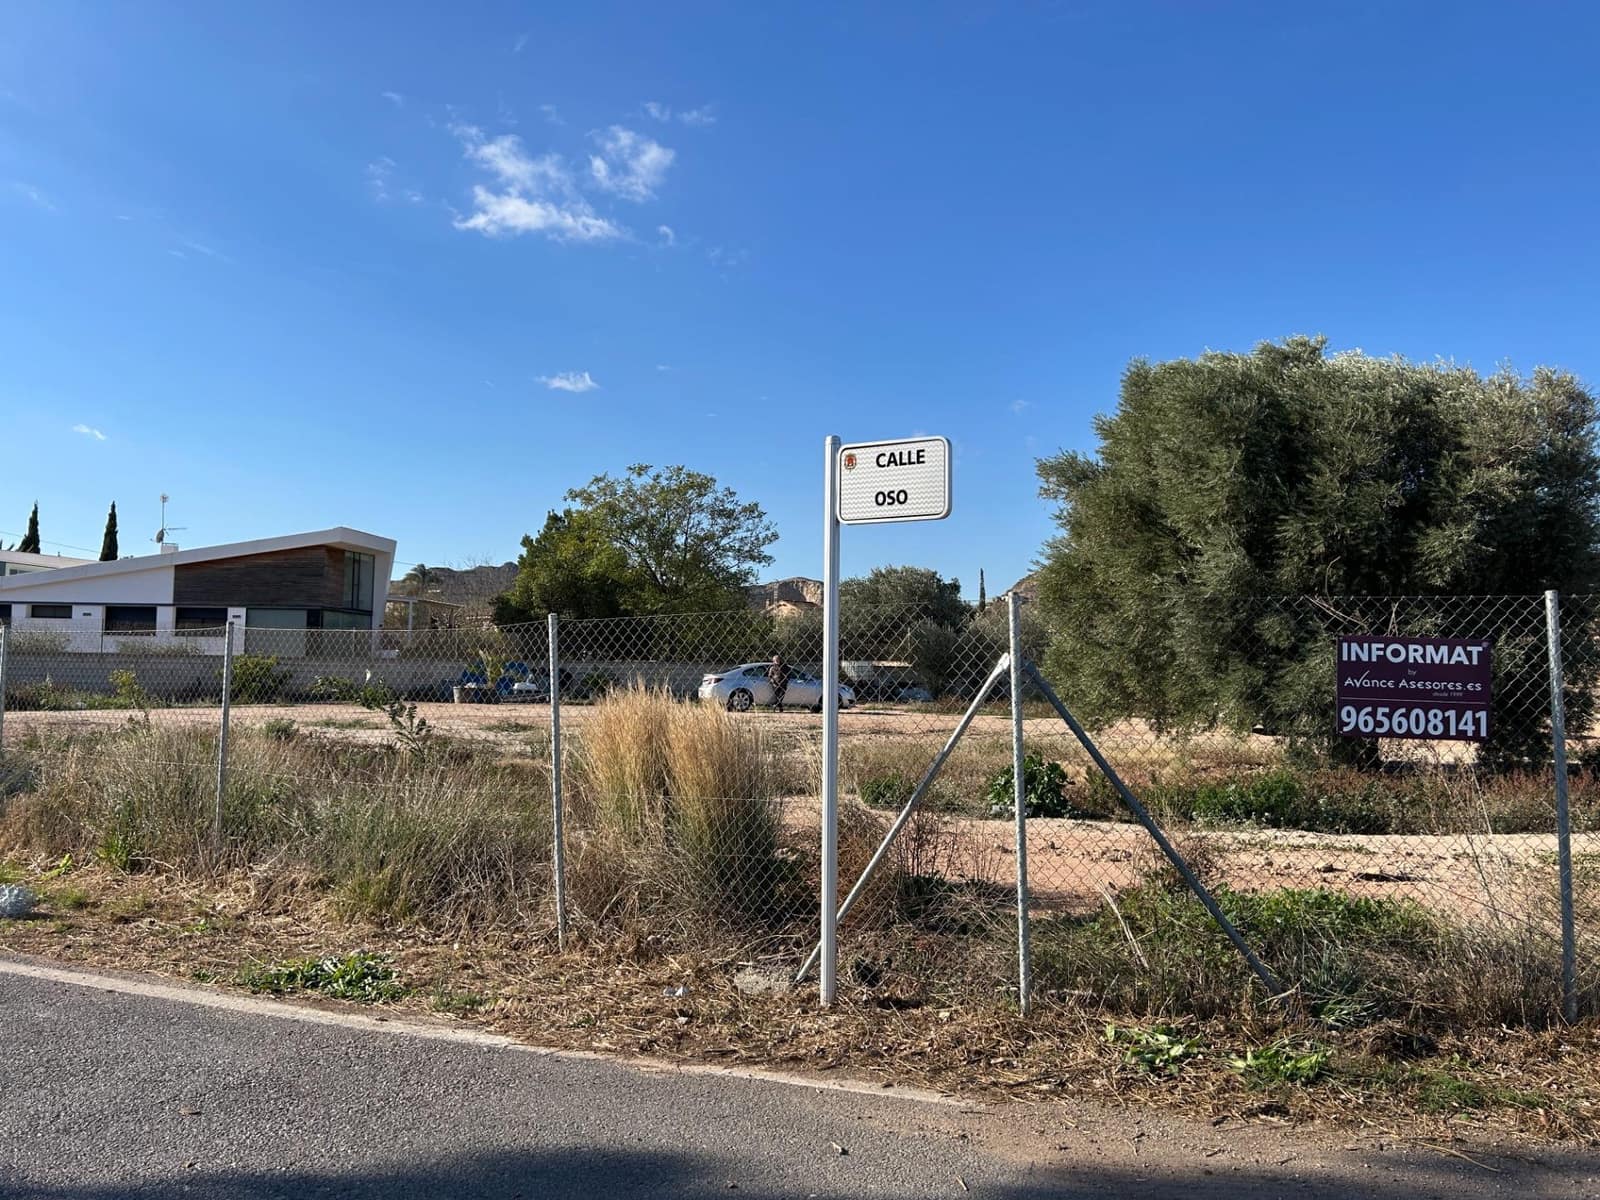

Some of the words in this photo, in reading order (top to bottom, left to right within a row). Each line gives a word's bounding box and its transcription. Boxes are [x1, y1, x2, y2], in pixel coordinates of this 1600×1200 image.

[875, 449, 926, 468] CALLE
[874, 489, 909, 506] OSO
[1341, 642, 1484, 666] INFORMAT
[1343, 670, 1395, 689] Avance
[1398, 679, 1483, 692] Asesores.es
[1340, 705, 1488, 738] 965608141
